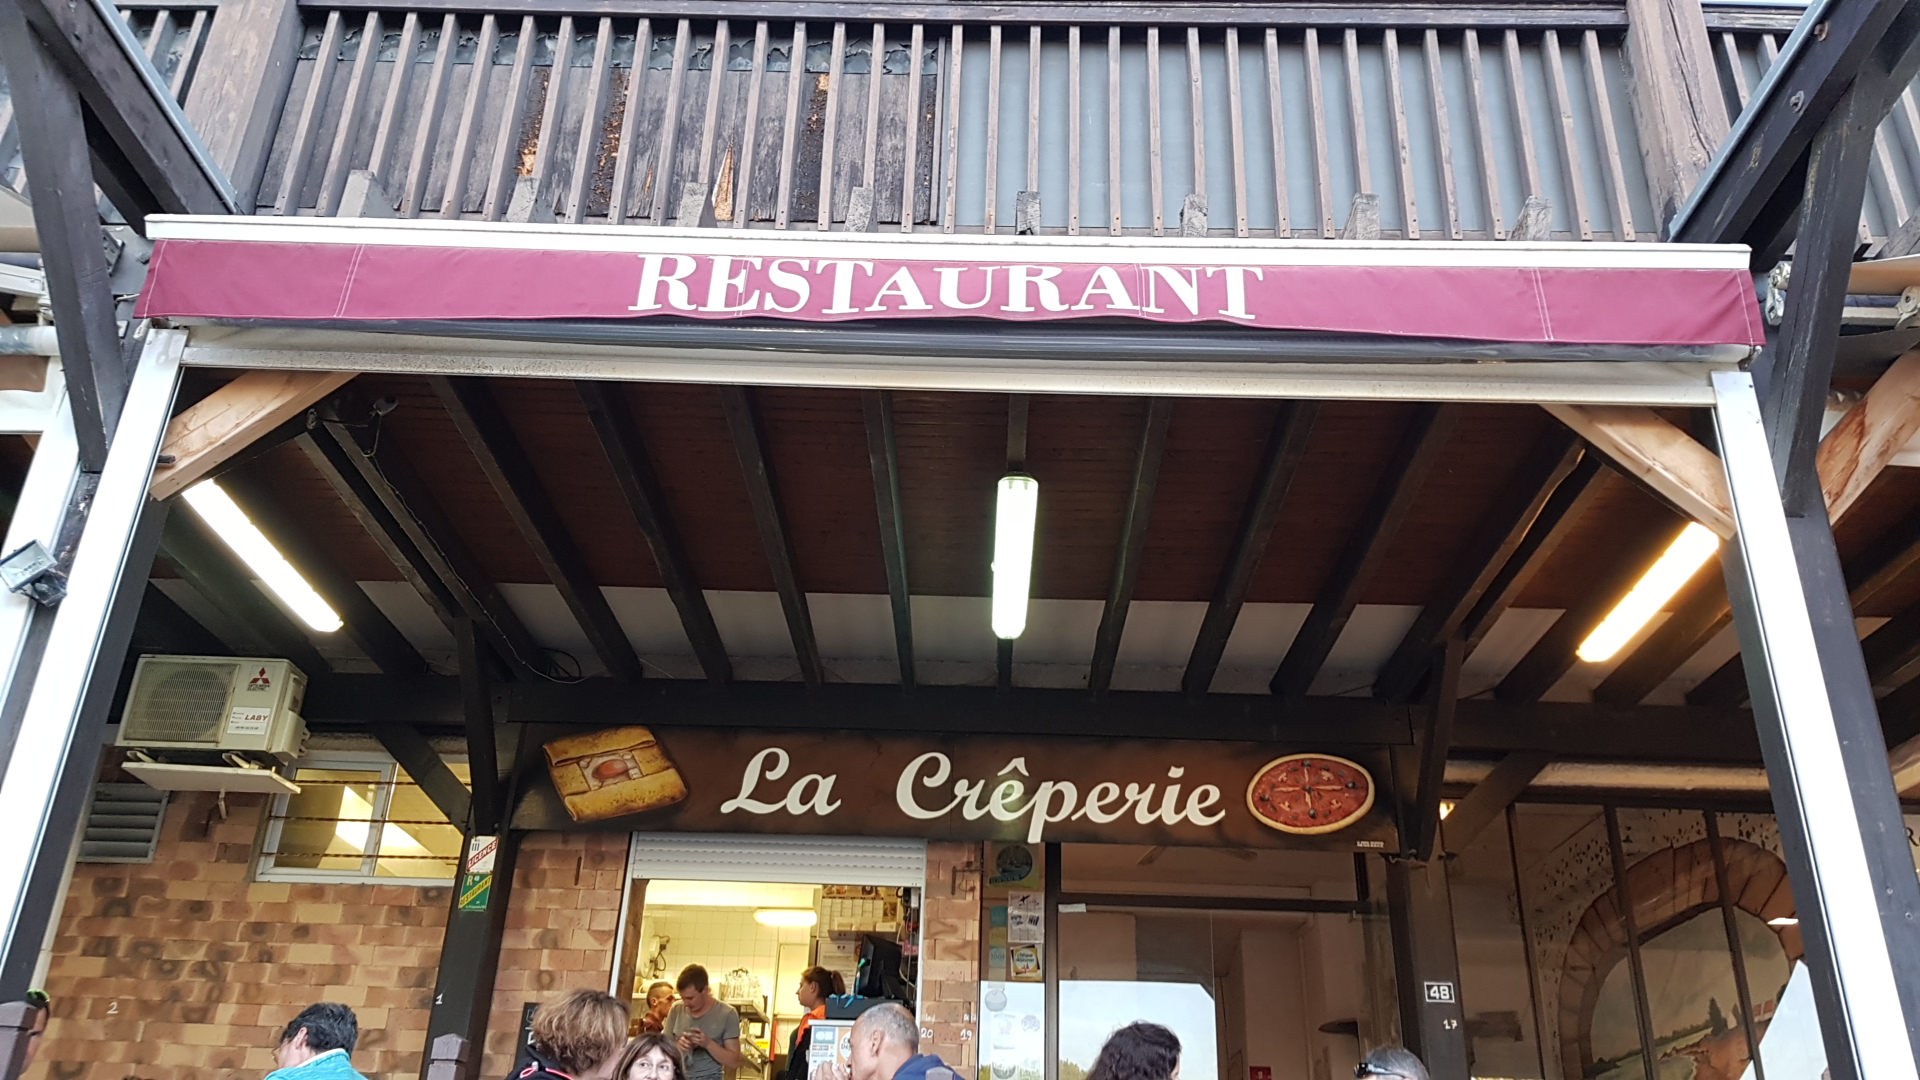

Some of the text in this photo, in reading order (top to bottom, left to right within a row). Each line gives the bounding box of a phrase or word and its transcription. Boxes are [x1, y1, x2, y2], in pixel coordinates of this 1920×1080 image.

[628, 253, 1264, 320] RESTAURANT
[720, 747, 1226, 843] La Crêperie
[467, 842, 497, 868] LICENCE
[106, 1001, 119, 1014] 2
[1443, 1019, 1458, 1030] 17
[920, 1027, 934, 1039] 20
[960, 1028, 973, 1041] 19
